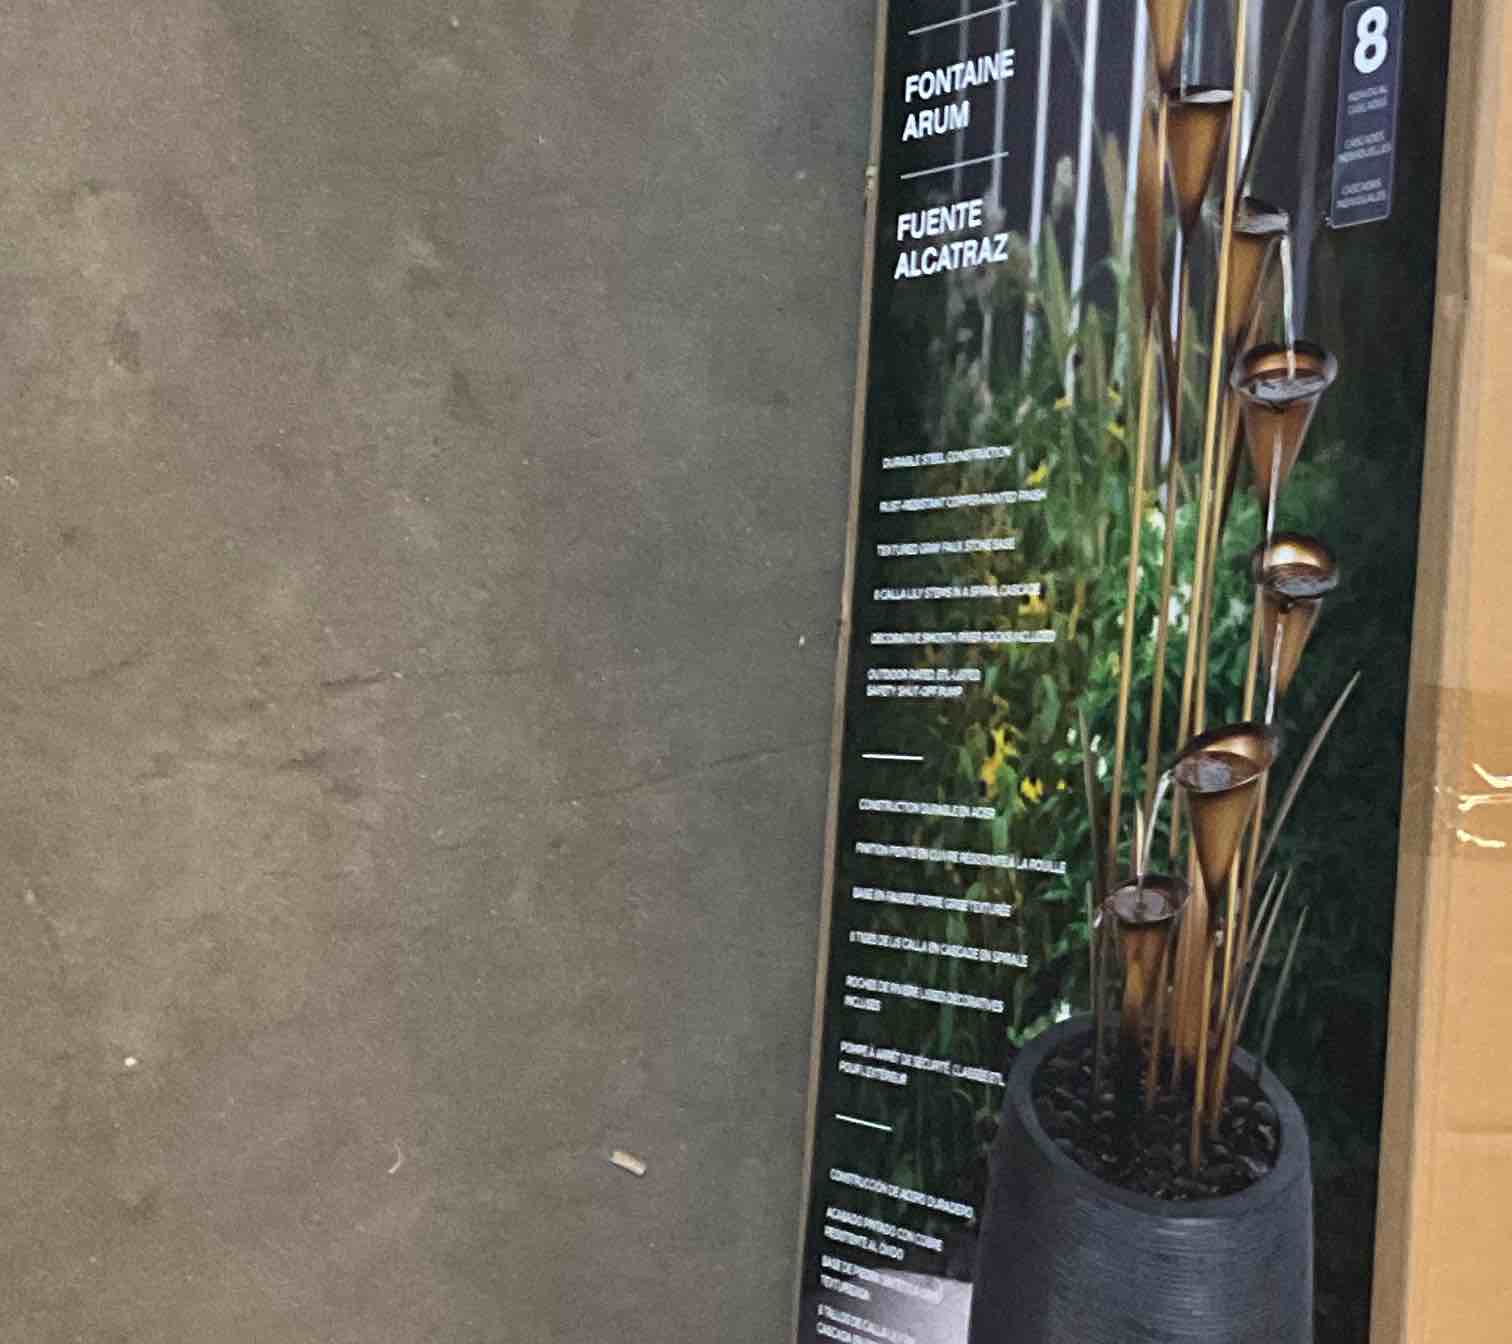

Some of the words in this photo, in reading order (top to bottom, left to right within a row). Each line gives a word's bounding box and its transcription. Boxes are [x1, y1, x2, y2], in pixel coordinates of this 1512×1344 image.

[1354, 6, 1389, 74] 8
[905, 48, 1016, 104] FONTAINE
[902, 100, 970, 142] ARUM
[897, 199, 984, 241] FUENTE
[894, 233, 1010, 281] ALCATRAZ
